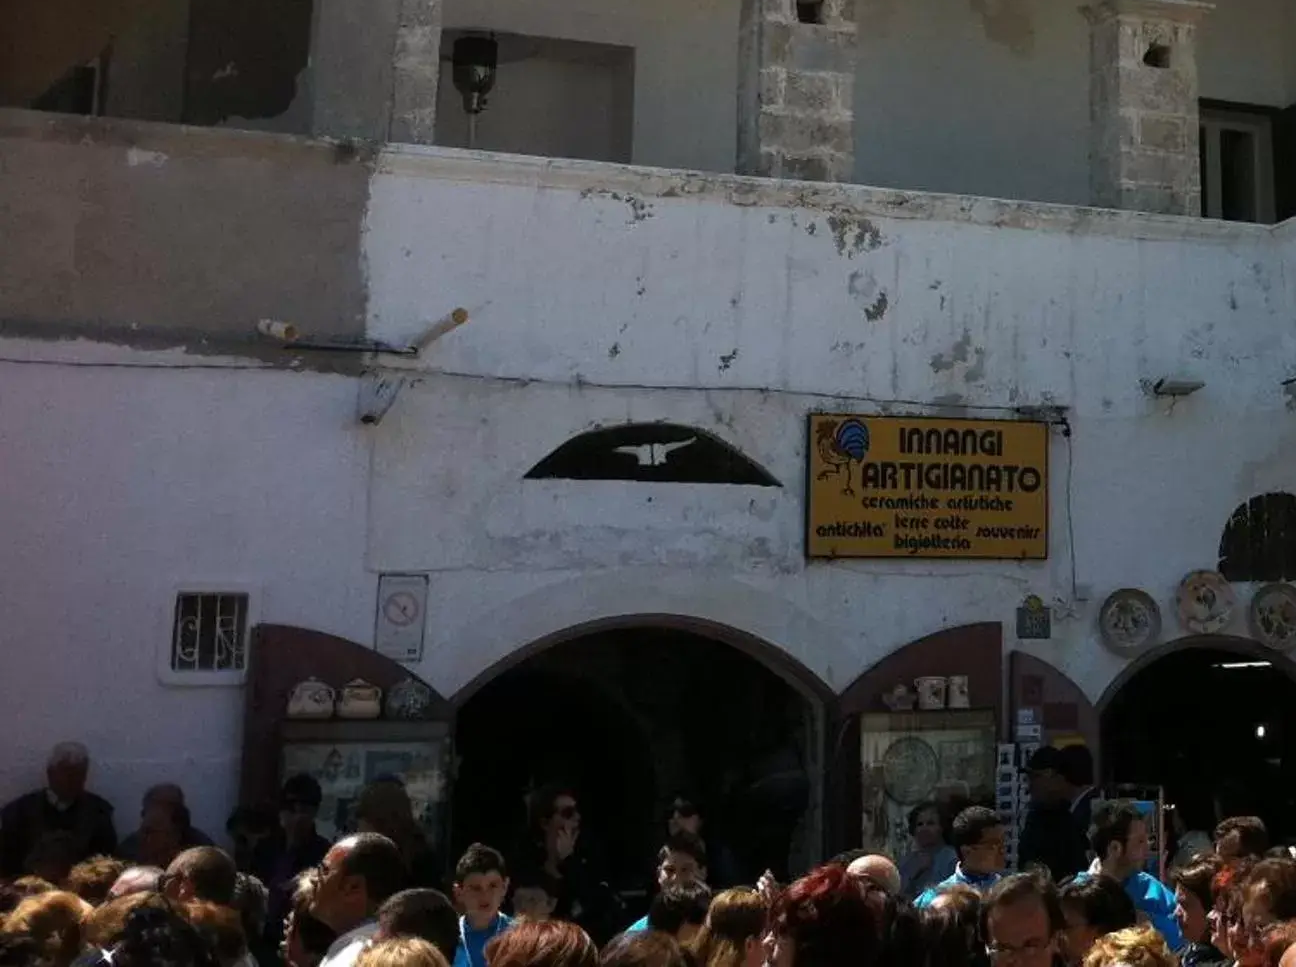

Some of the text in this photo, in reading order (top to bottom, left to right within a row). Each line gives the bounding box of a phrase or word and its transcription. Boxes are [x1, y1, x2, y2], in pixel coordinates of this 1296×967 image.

[899, 427, 1003, 456] INNANGI
[861, 462, 1041, 492] ARTIGIANATO
[861, 495, 940, 510] ceramiche
[894, 515, 970, 530] terre cotte
[976, 525, 1041, 540] souvenirs
[894, 534, 971, 554] bigiotteria
